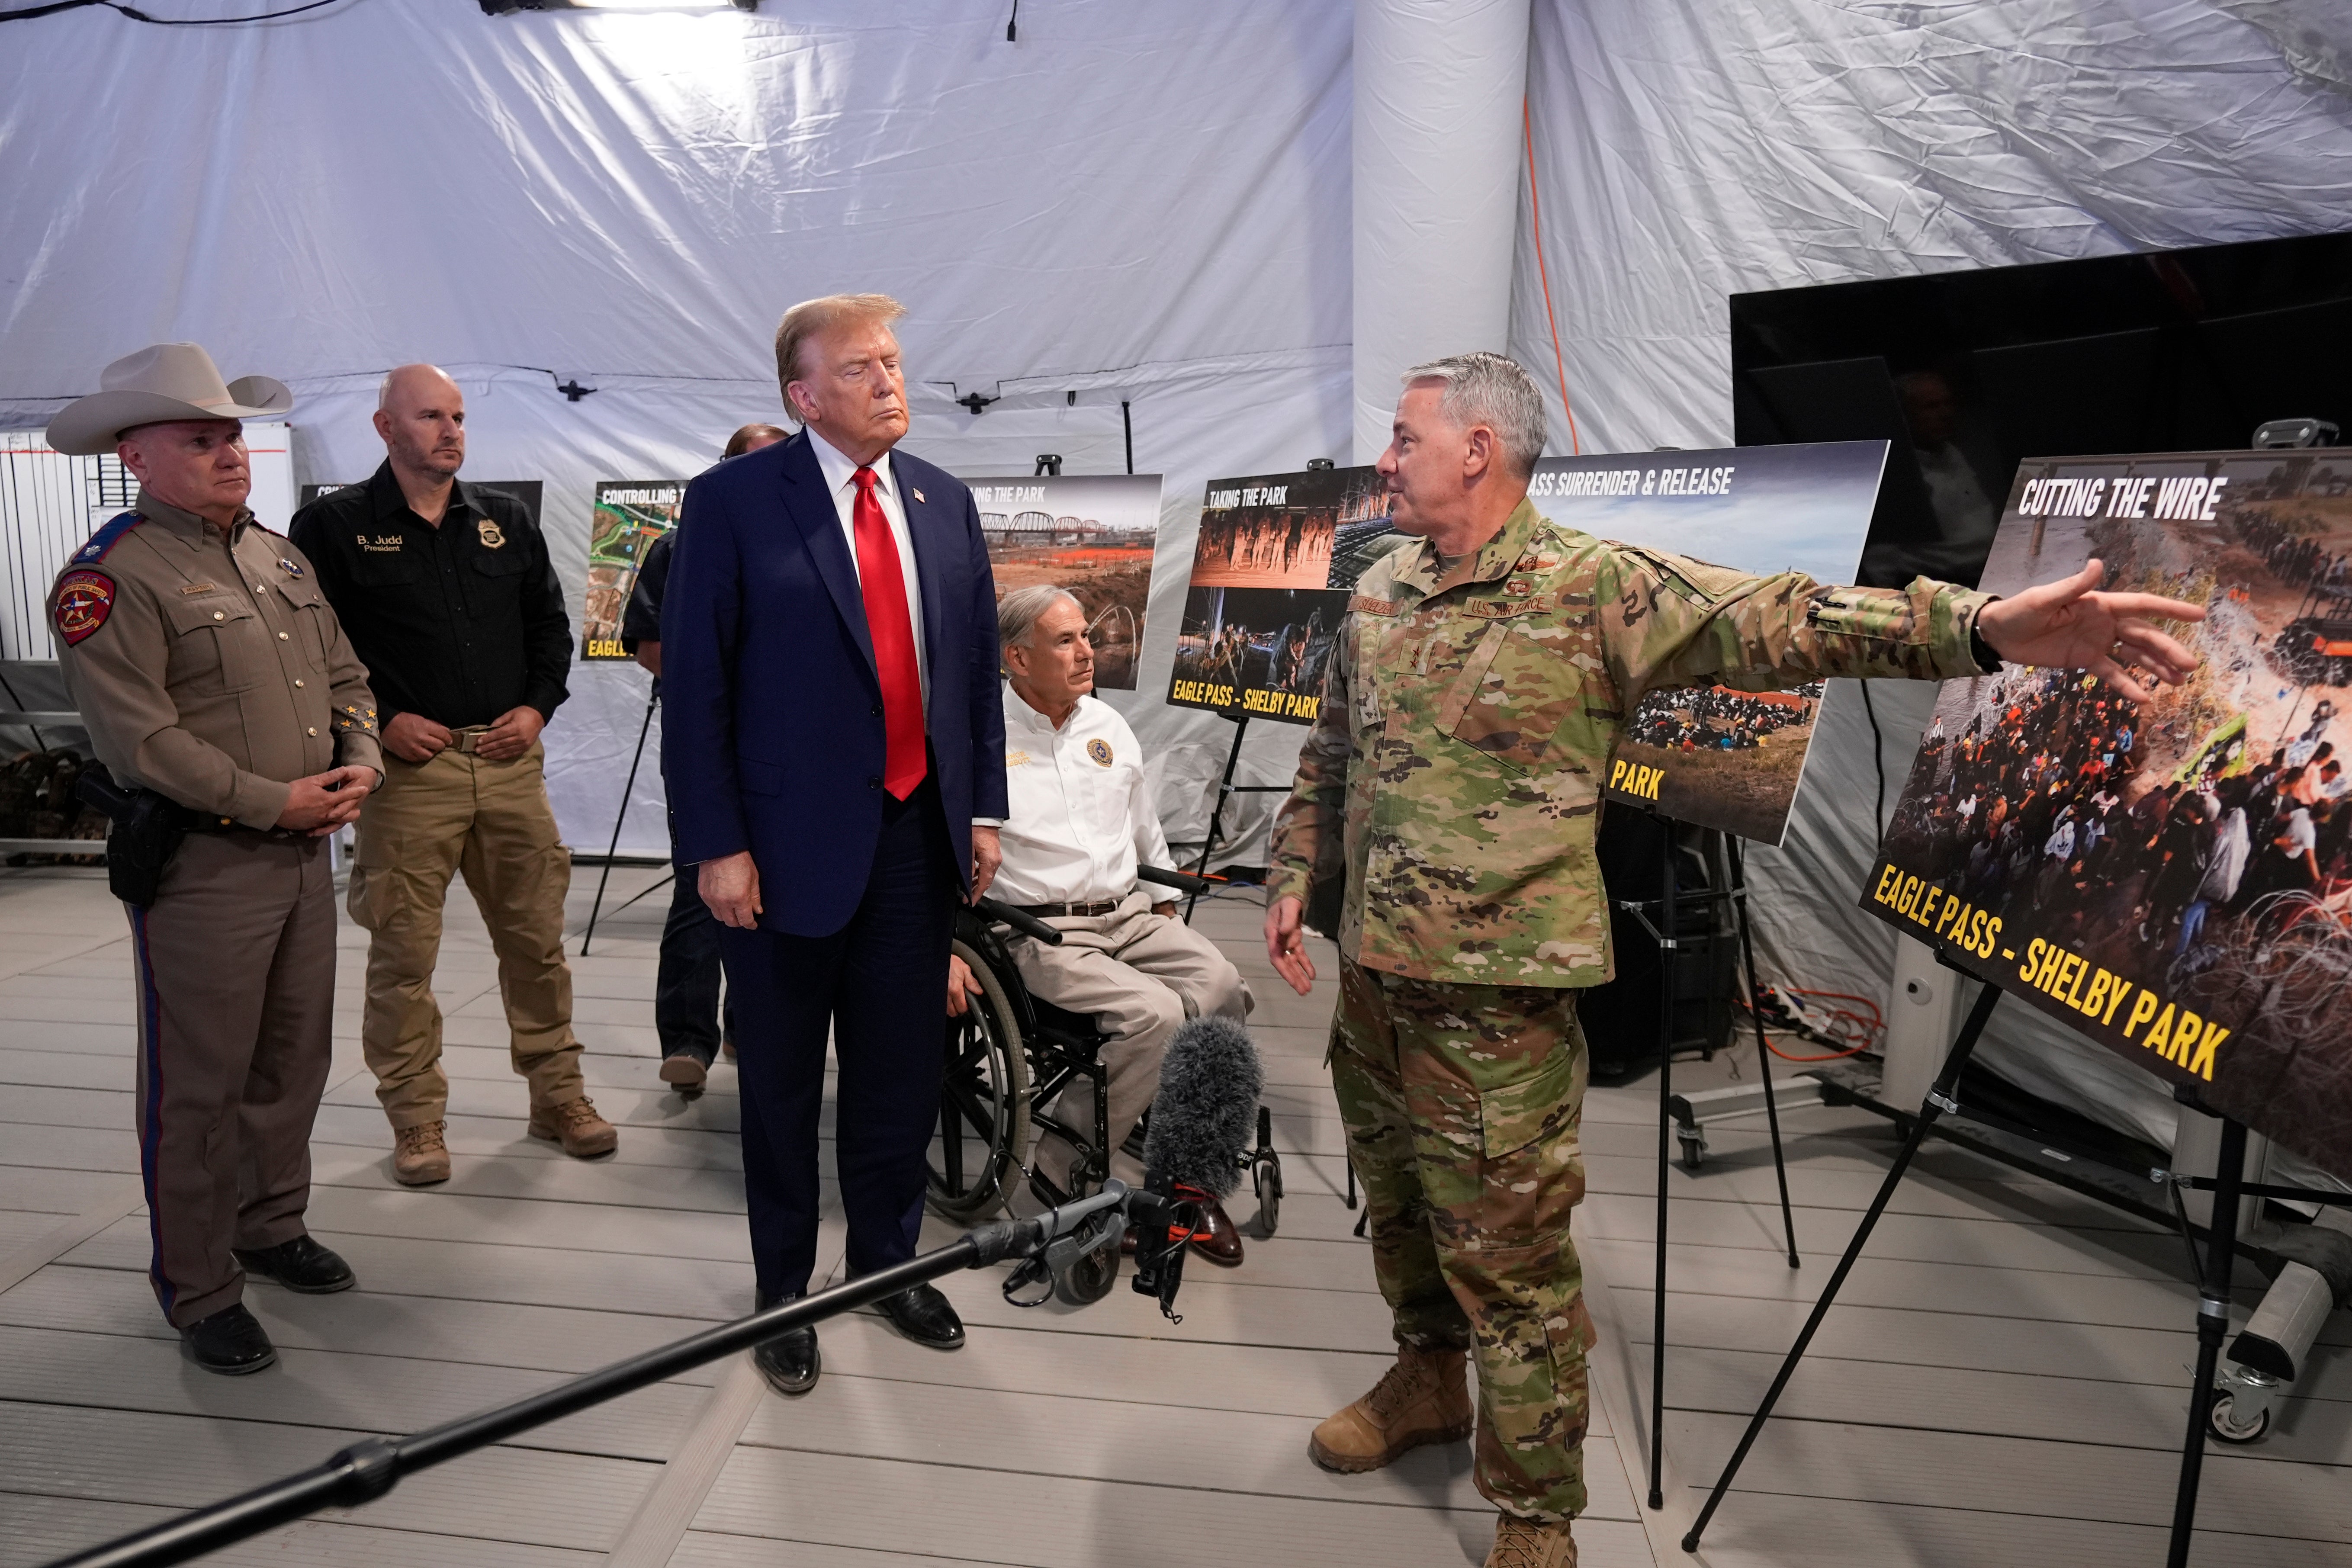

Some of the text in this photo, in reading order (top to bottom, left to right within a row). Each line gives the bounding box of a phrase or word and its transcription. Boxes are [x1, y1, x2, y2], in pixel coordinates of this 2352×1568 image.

[995, 487, 1014, 502] THE
[1016, 486, 1045, 502] PARK
[1526, 467, 1735, 497] ASS SURRENDER & RELEASE
[602, 489, 677, 505] CONTROLLING
[1210, 485, 1288, 508] TAKING THE PARK
[2018, 477, 2229, 521] CUTTING THE WIRE
[357, 535, 403, 545] B. Judd
[1472, 596, 1545, 616] U.S. AIR FORCE
[1173, 679, 1205, 703] EAGLE
[1204, 684, 1234, 707] PASS
[1243, 688, 1286, 714] SHELBY
[1285, 693, 1321, 720] PARK
[1609, 759, 1665, 800] PARK
[1874, 864, 2231, 1082] EAGLE PASS - SHELBY PARK
